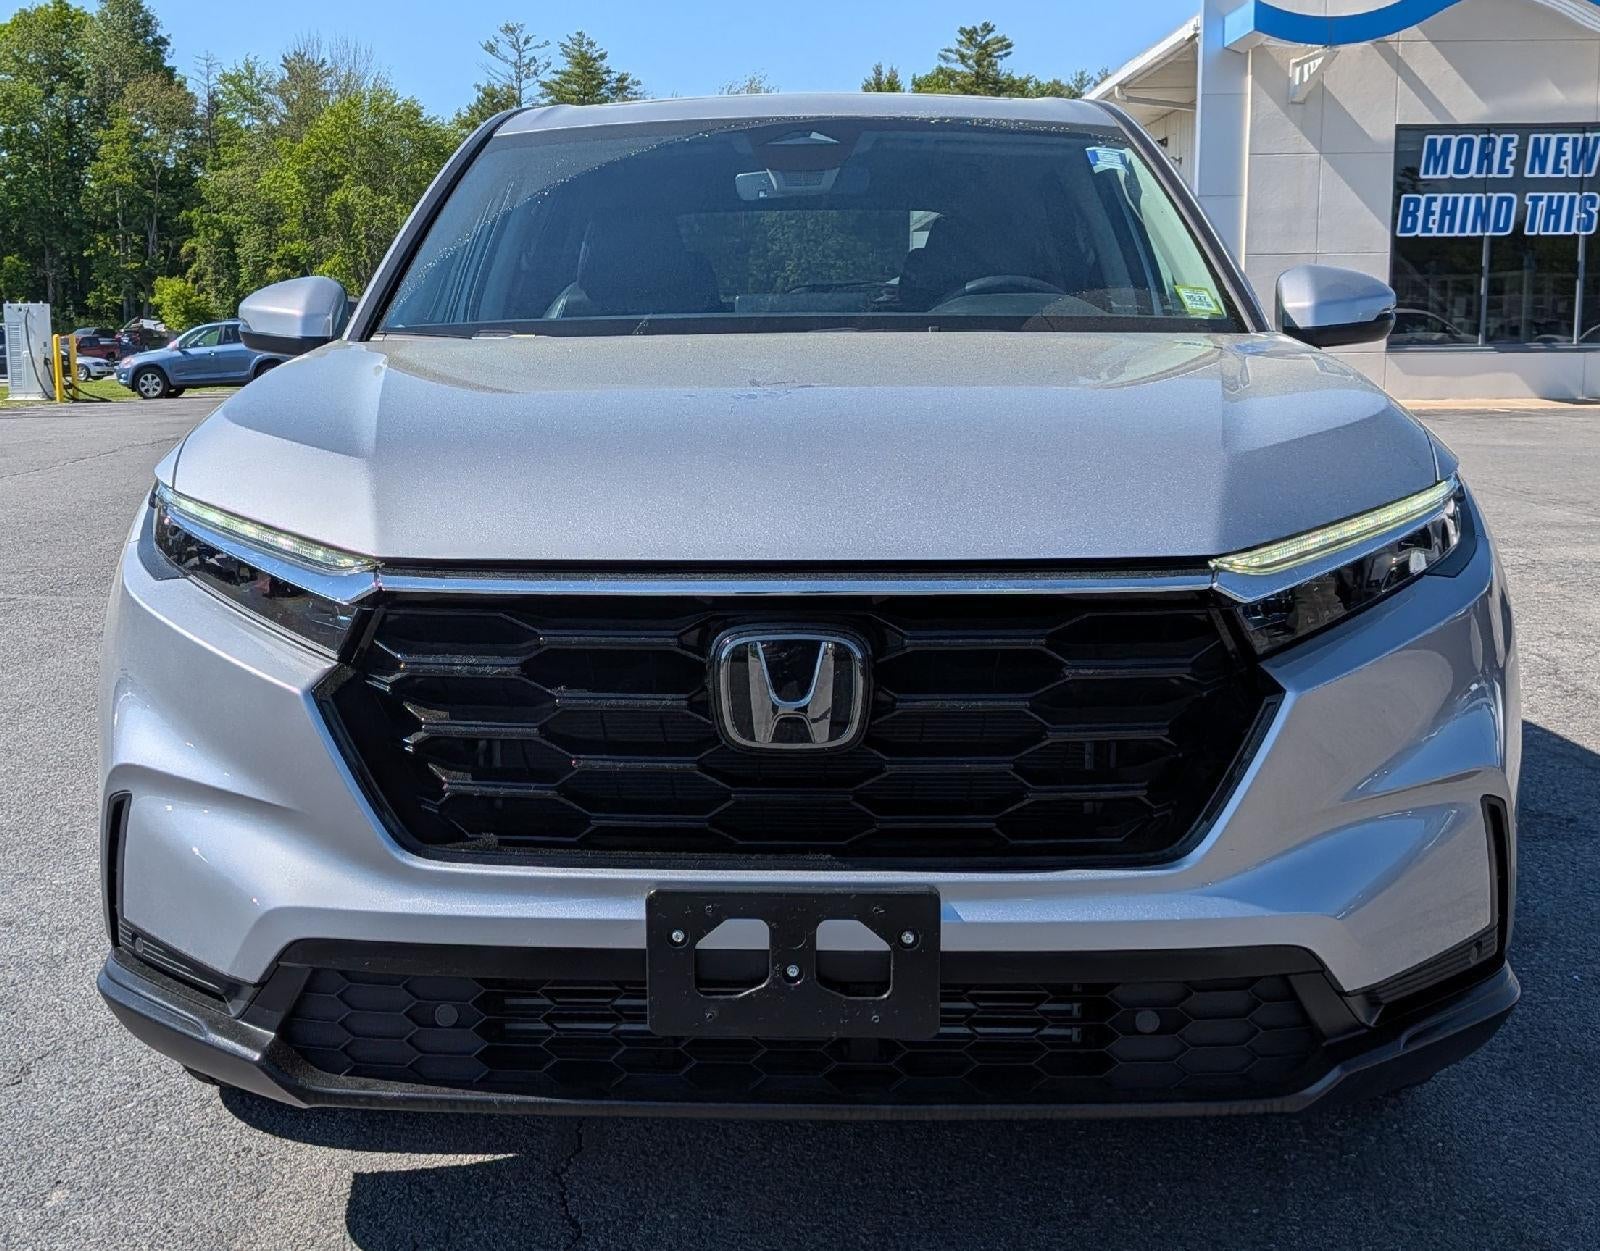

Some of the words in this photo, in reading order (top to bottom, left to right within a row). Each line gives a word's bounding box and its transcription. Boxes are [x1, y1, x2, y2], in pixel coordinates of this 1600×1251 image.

[1420, 134, 1519, 178] MORE
[1524, 133, 1600, 177] NEW
[1396, 193, 1517, 236] BEHIND
[1524, 192, 1600, 235] THIS
